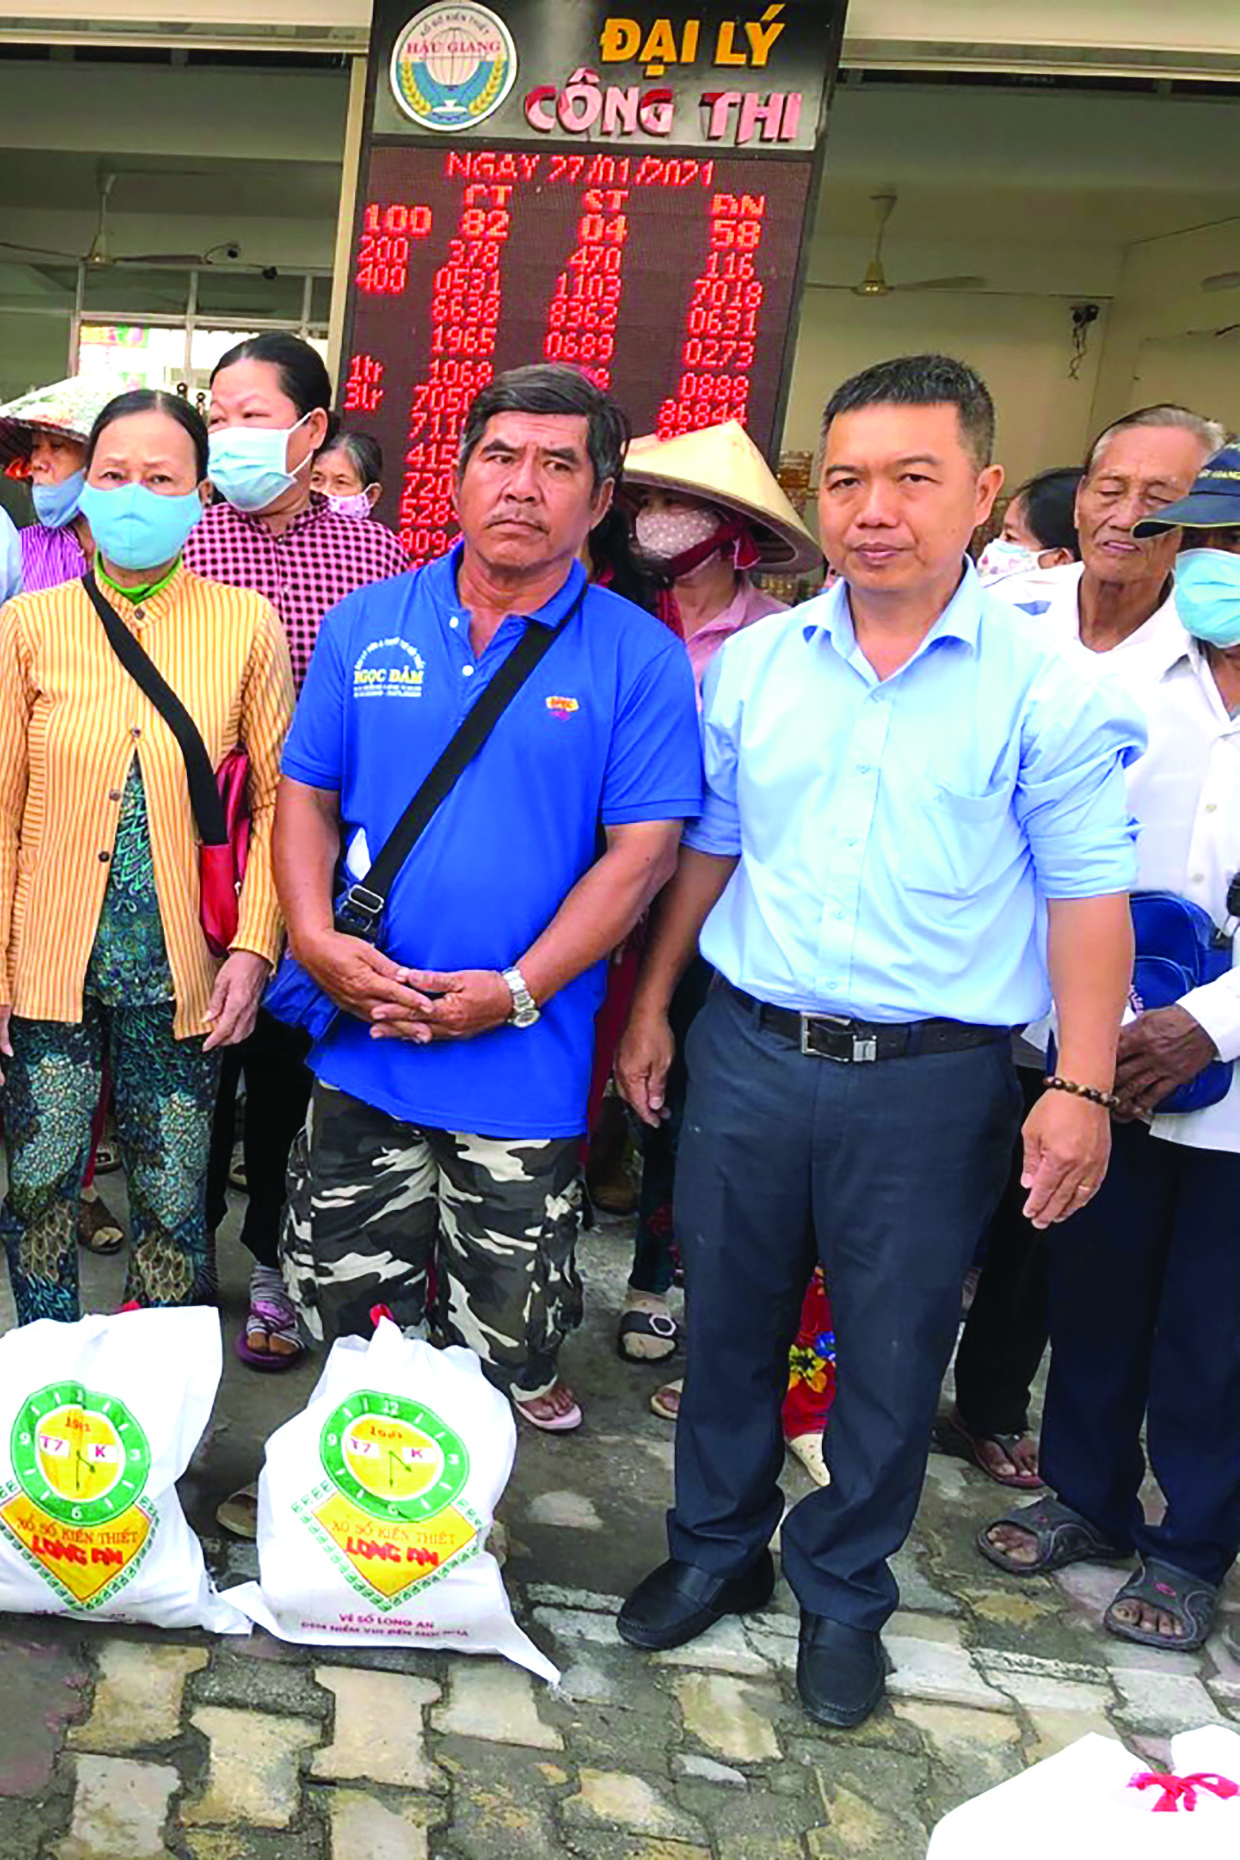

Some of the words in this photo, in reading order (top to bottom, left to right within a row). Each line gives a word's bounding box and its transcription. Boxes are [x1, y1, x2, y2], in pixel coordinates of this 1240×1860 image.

[447, 41, 501, 54] GIANG
[600, 18, 700, 77] ĐẠI
[714, 3, 786, 65] LÝ
[525, 67, 675, 133] CÔNG
[701, 92, 802, 142] THI
[447, 151, 540, 179] NGAY
[584, 189, 628, 212] ST
[365, 204, 432, 238] 100
[462, 209, 510, 239] 82
[579, 214, 627, 244] 04
[711, 220, 761, 250] 58
[358, 235, 408, 264] 200
[448, 239, 500, 269] 378
[569, 246, 622, 275] 470
[706, 252, 754, 281] 116
[356, 264, 406, 293] 400
[434, 268, 501, 296] 0531
[556, 273, 622, 300] 1103
[692, 279, 763, 308] 7018
[549, 301, 618, 331] 8362
[688, 307, 756, 338] 0631
[432, 325, 497, 356] 1965
[544, 332, 614, 361] 0689
[684, 338, 755, 368] 0273
[680, 372, 749, 401] 0888
[658, 399, 748, 427] 86844
[382, 1400, 399, 1416] 12
[19, 1432, 31, 1445] 9
[40, 1435, 64, 1452] T7
[327, 1434, 338, 1446] 9
[95, 1445, 106, 1458] K
[131, 1449, 141, 1461] 3
[411, 1448, 424, 1459] K
[449, 1453, 459, 1465] 3
[71, 1506, 82, 1520] 6
[98, 1527, 138, 1545] THIẾT
[355, 1521, 373, 1536] SỐ
[378, 1527, 409, 1541] KIẾN
[416, 1531, 456, 1545] THIẾT
[31, 1535, 88, 1566] LONG
[91, 1547, 123, 1566] AN
[344, 1536, 402, 1564] LONG
[406, 1547, 440, 1567] AN
[358, 1613, 375, 1625] SỐ
[377, 1616, 413, 1627] LONG
[416, 1621, 435, 1630] AN
